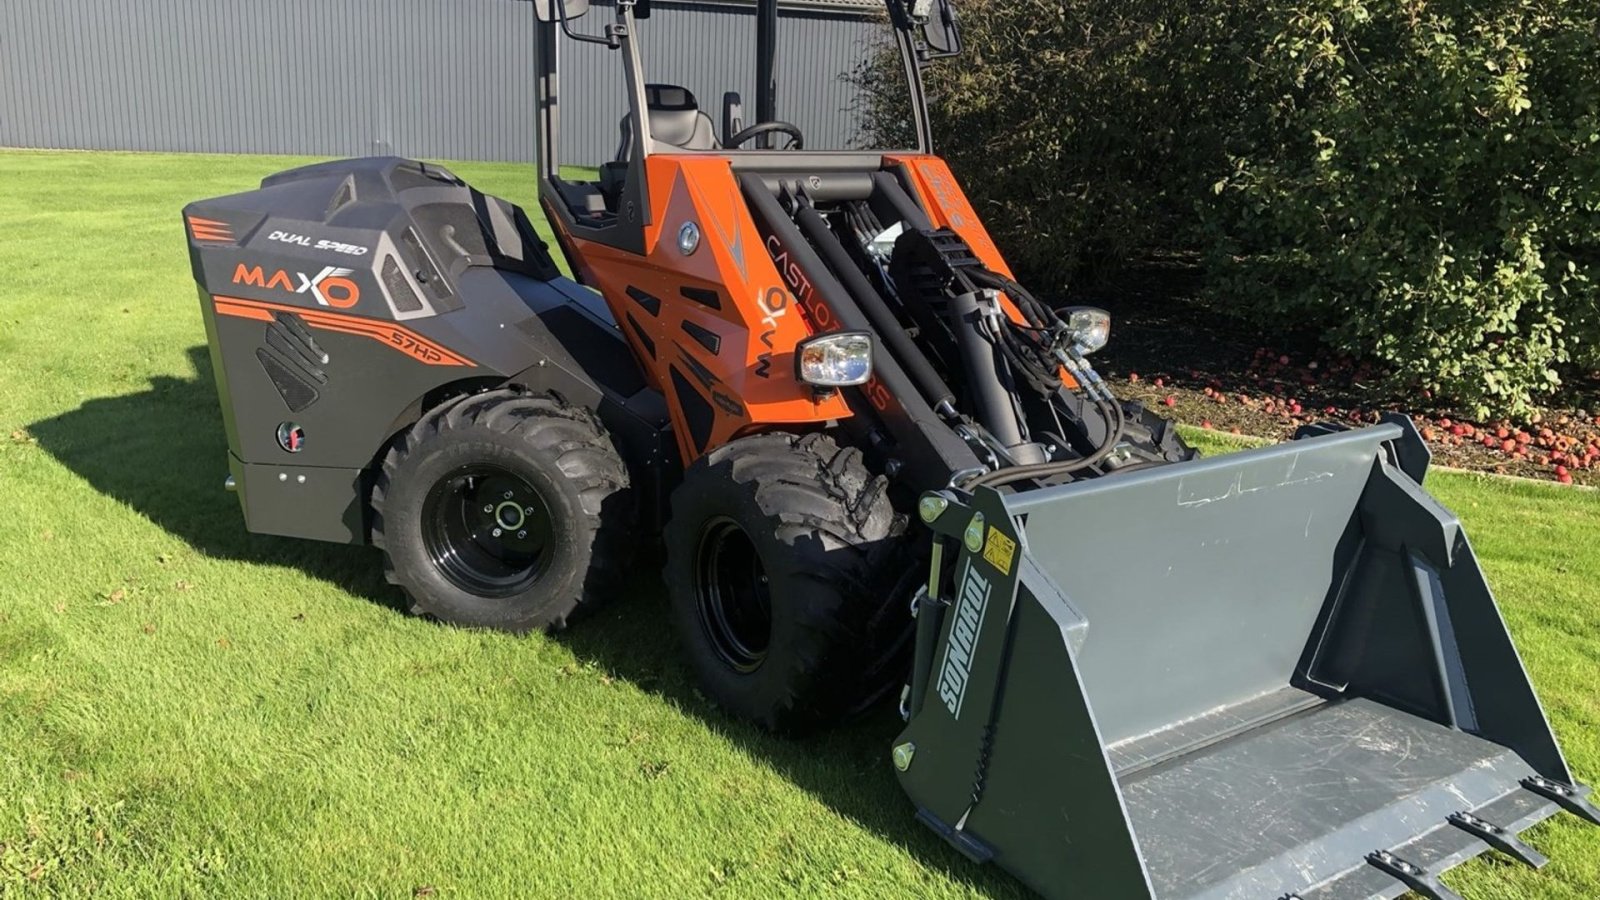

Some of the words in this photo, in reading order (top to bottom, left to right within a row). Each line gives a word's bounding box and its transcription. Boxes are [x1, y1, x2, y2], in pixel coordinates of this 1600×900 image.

[268, 230, 311, 246] DUAL
[314, 239, 369, 256] SPEED
[232, 263, 360, 309] MAXO
[391, 331, 442, 363] 57HP
[754, 286, 788, 379] MAXO
[767, 234, 890, 410] CASTLORS
[939, 564, 989, 714] SONAROL
